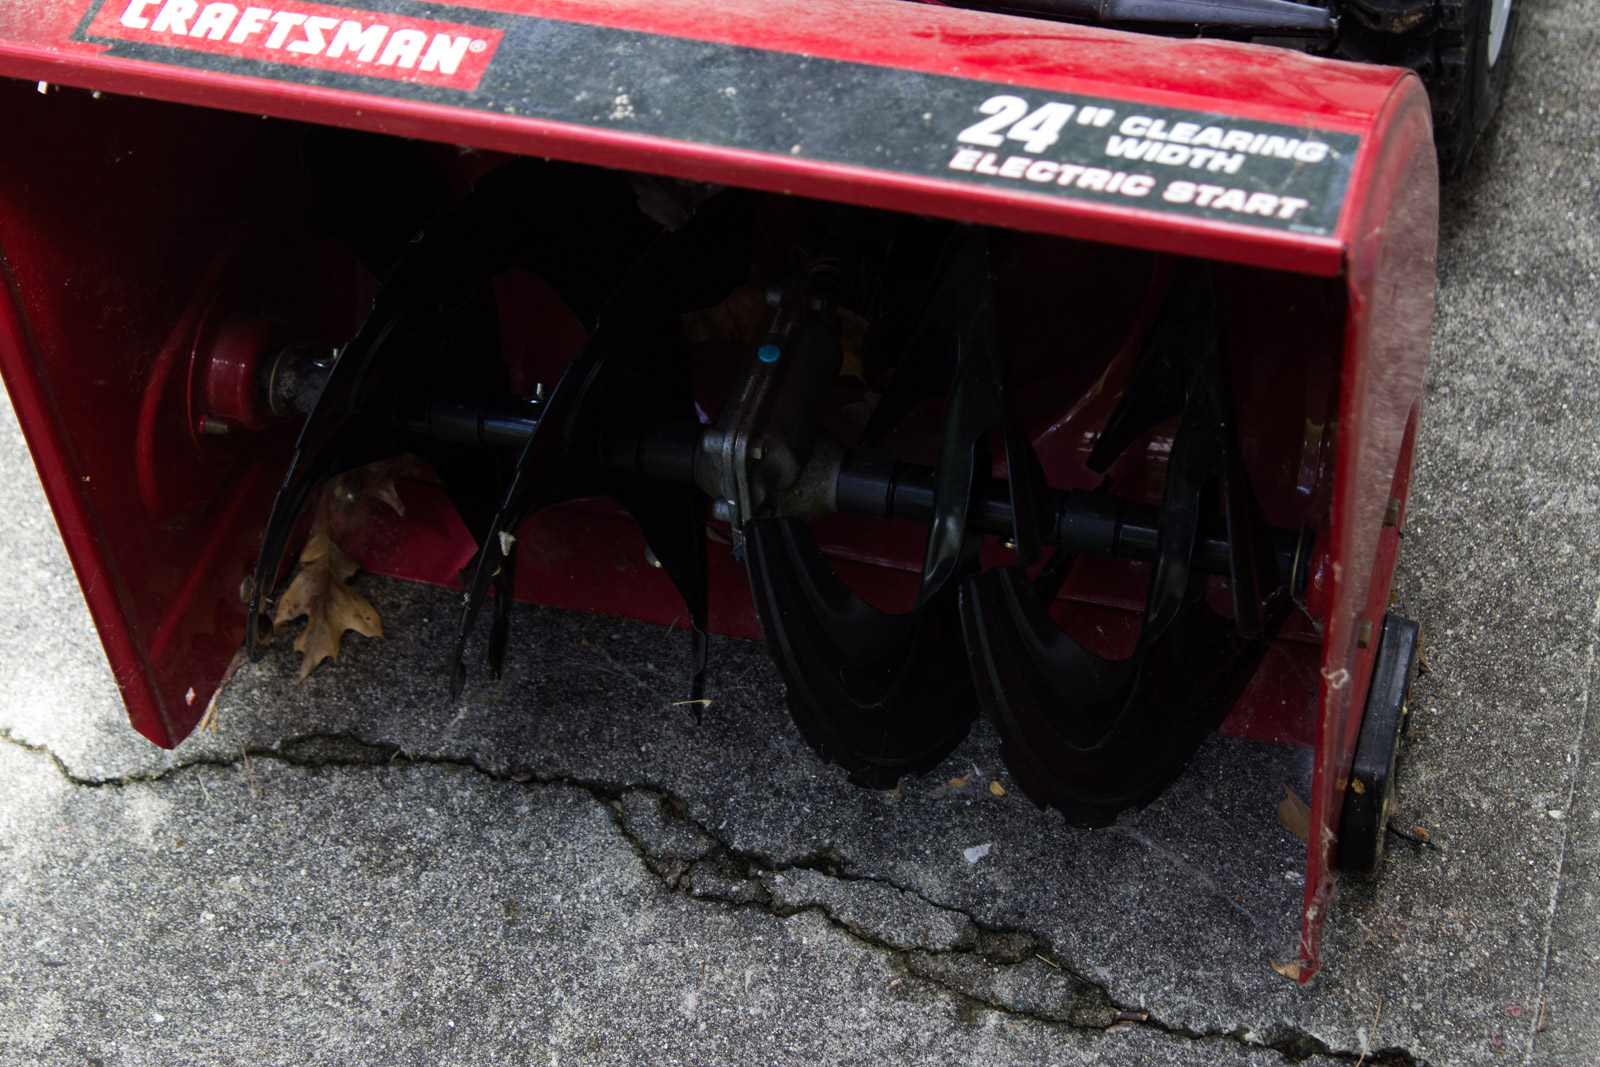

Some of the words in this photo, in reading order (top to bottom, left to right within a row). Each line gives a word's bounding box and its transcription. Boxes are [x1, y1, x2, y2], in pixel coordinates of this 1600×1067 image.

[957, 95, 1115, 154] 24"
[1119, 115, 1330, 163] CLEARING
[1105, 135, 1246, 175] WIDTH
[948, 149, 1156, 197] ELECTRIC
[1162, 180, 1309, 219] START
